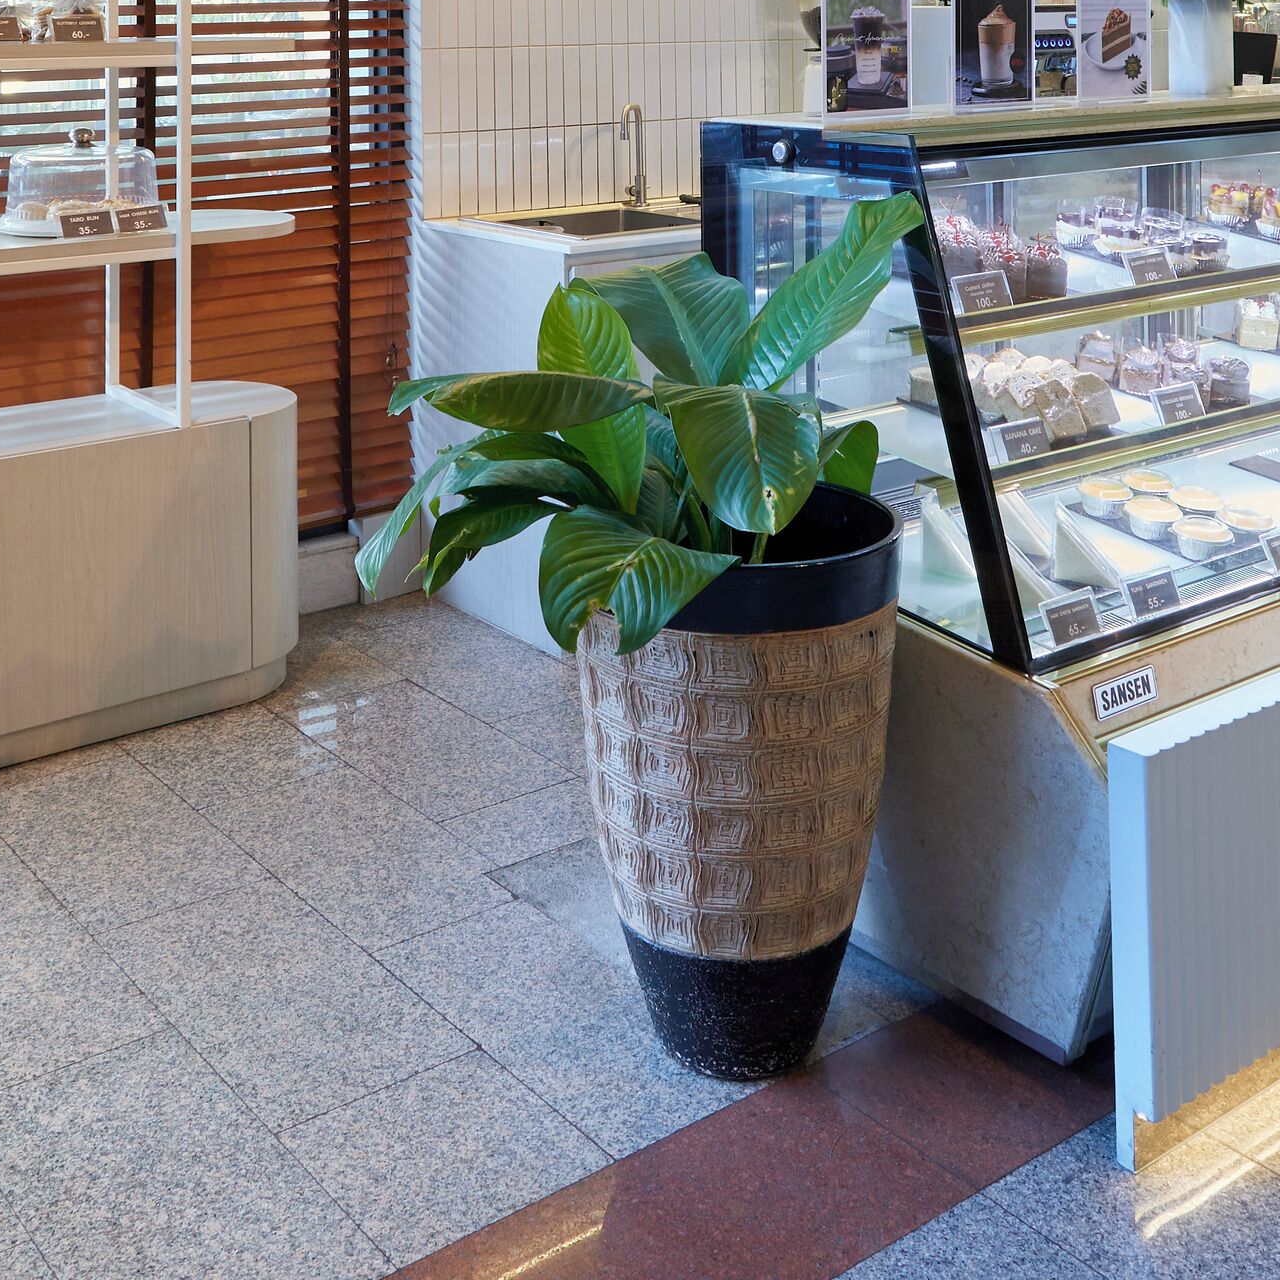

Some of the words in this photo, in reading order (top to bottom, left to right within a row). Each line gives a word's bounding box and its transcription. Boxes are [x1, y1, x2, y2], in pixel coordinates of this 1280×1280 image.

[71, 30, 90, 39] 60.-
[78, 226, 98, 235] 35.-
[134, 220, 152, 229] 35.-
[1145, 271, 1162, 282] 100.-
[976, 296, 997, 309] 100.-
[1174, 409, 1192, 421] 100.-
[1005, 430, 1028, 441] BANANA
[1029, 427, 1042, 436] CAKE
[1021, 442, 1037, 455] 40.-
[1145, 578, 1169, 590] SANDWICH
[1071, 603, 1089, 613] SANDWICH
[1148, 596, 1165, 609] 55.-
[1068, 623, 1086, 636] 65.-
[1100, 673, 1152, 712] SANSEN
